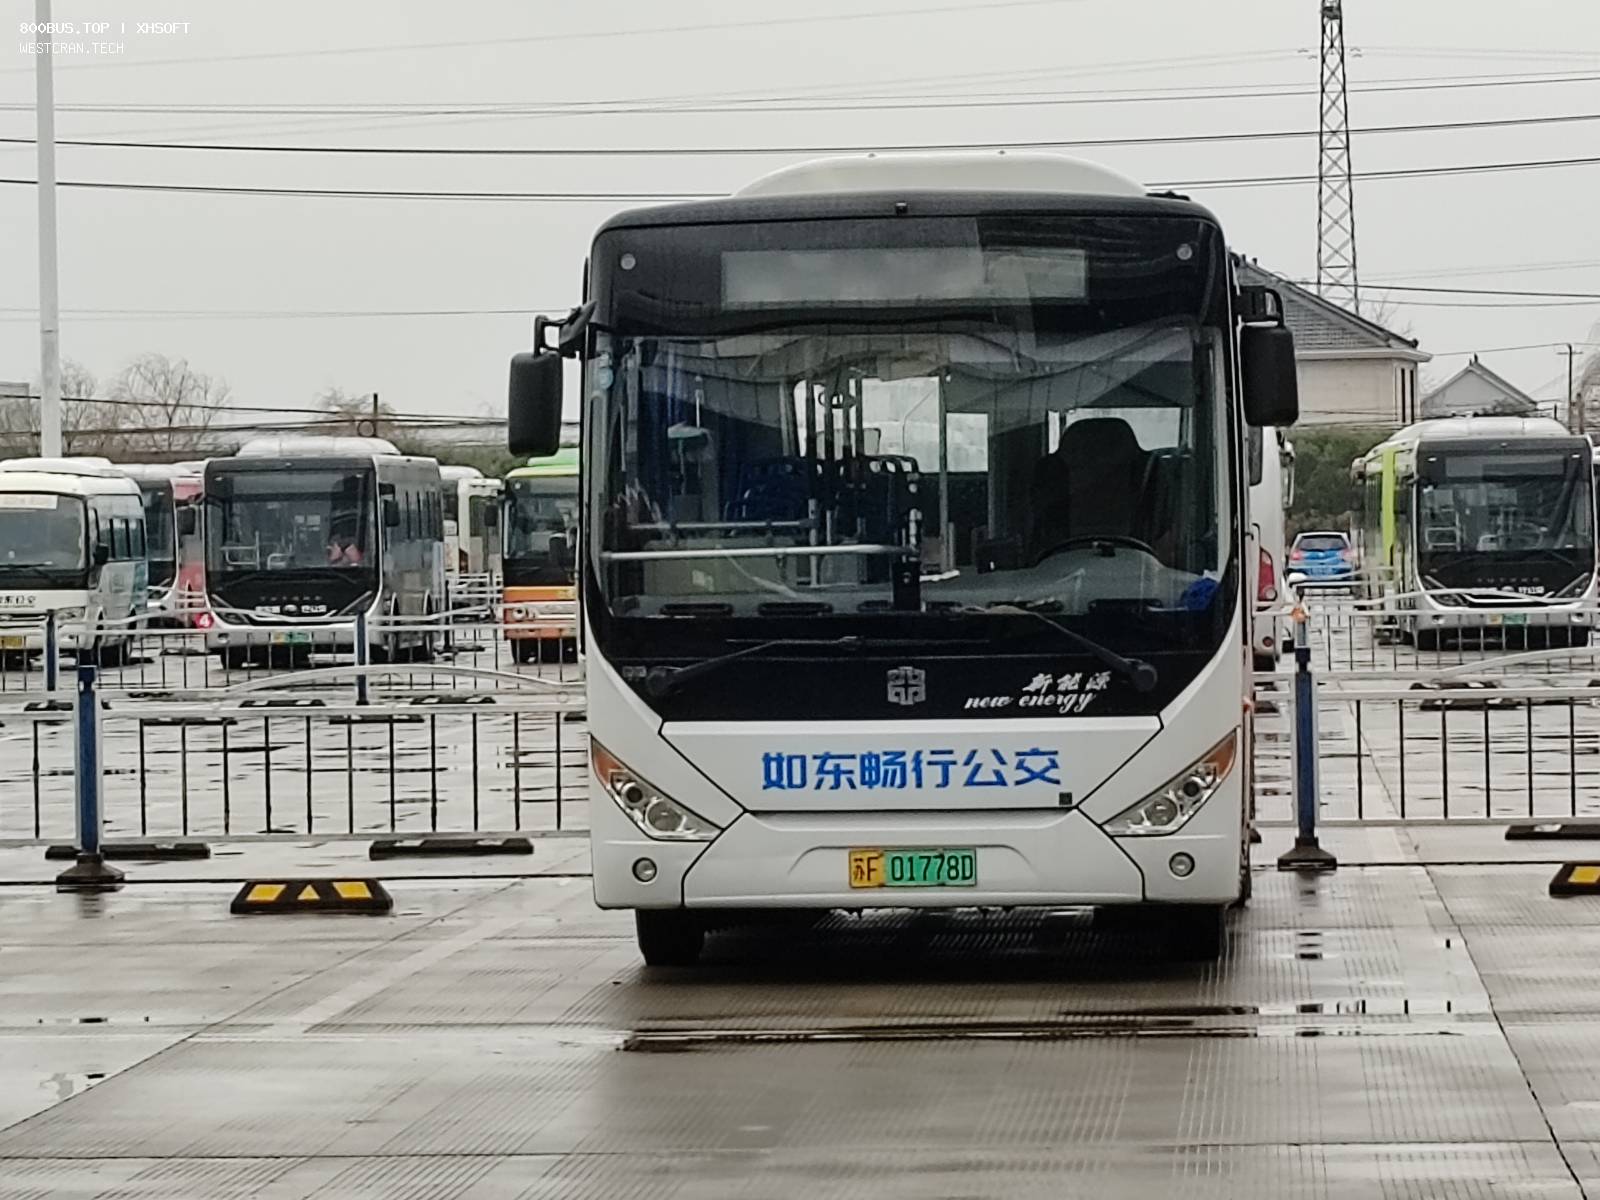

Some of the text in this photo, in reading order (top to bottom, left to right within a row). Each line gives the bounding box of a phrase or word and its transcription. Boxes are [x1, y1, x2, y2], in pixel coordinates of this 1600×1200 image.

[1022, 670, 1112, 694] 新能源
[964, 692, 1096, 714] new energy
[761, 747, 1062, 791] 如东畅行公交
[890, 855, 974, 881] 01778D
